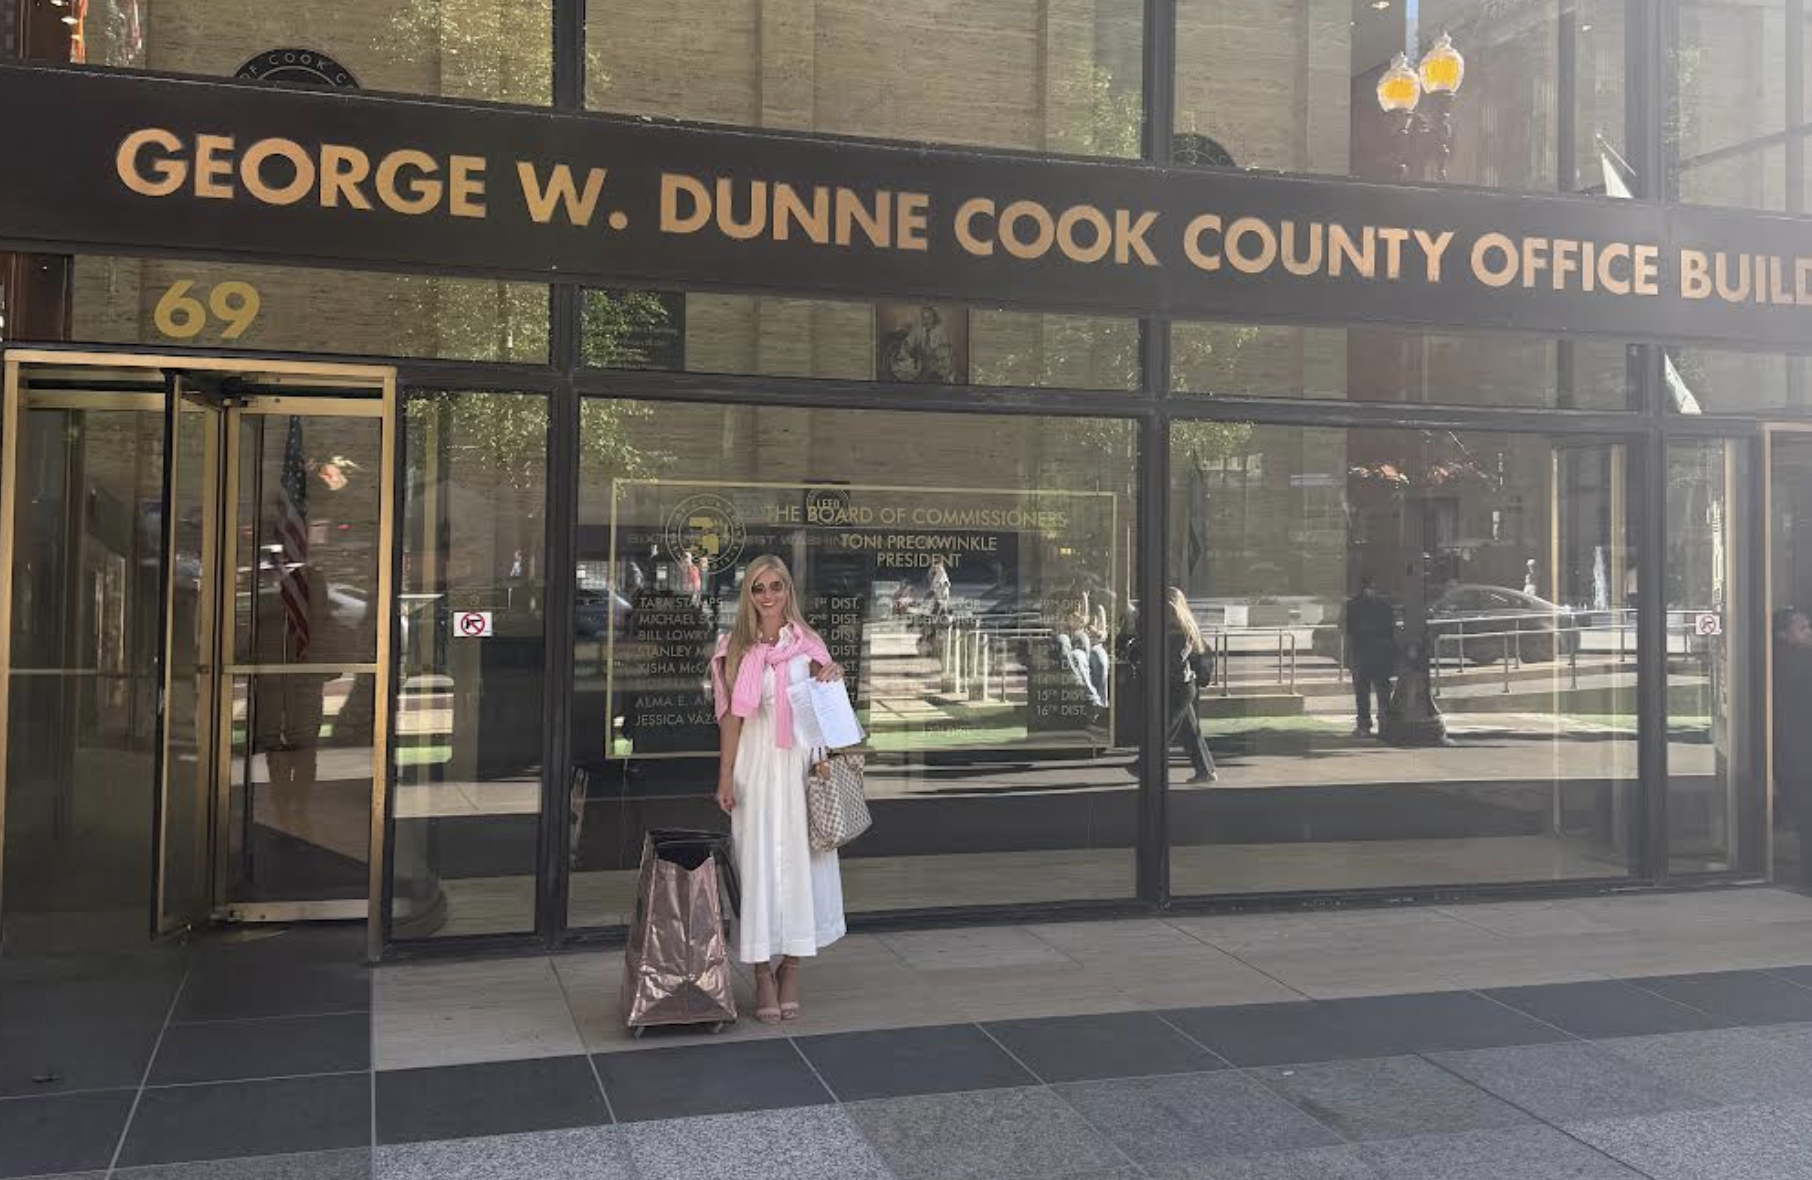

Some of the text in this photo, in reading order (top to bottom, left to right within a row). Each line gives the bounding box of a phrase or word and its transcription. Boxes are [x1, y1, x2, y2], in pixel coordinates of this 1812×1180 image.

[268, 52, 325, 69] COOK
[116, 128, 487, 218] GEORGE
[516, 161, 628, 230] W.
[660, 173, 930, 251] DUNNE
[954, 197, 1162, 266] COOK
[1184, 214, 1454, 282] COUNTY
[1470, 233, 1659, 296] OFFICE
[154, 280, 260, 339] 69
[766, 503, 1068, 527] THE BOARD OF COMMISSIONERS
[840, 533, 998, 551] TONI PRECKWINKLE
[876, 551, 962, 568] PRESIDENT
[831, 597, 860, 609] DIST.
[639, 613, 695, 624] MICHAEL
[638, 630, 662, 641] BILL
[638, 662, 675, 673] ISHA
[635, 696, 673, 708] ALMA
[635, 714, 685, 726] JESSICA
